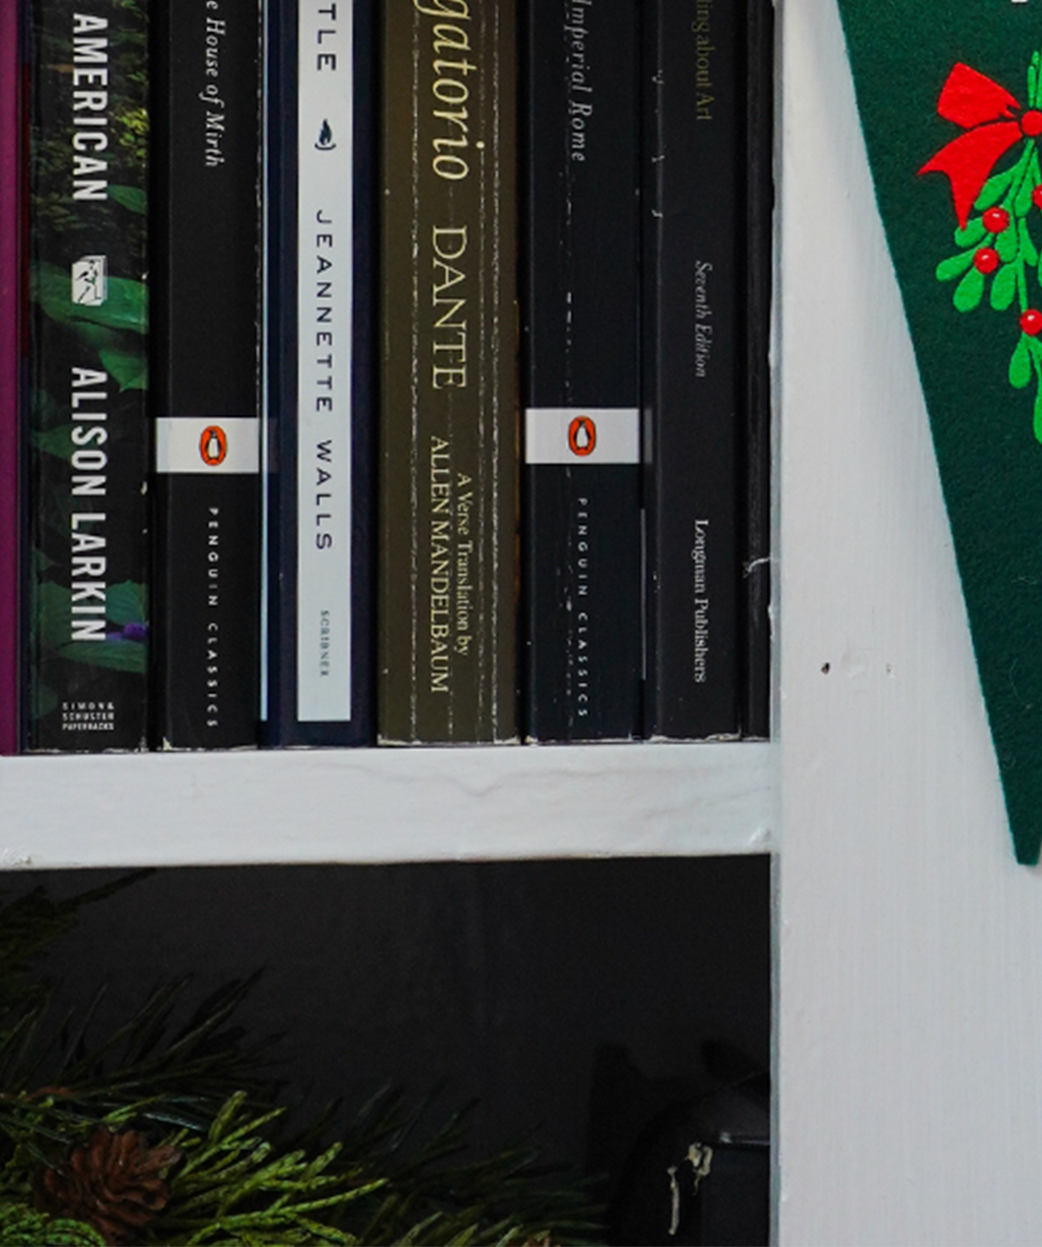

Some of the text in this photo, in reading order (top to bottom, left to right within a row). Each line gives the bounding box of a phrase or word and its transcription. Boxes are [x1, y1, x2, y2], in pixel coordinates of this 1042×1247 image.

[198, 80, 227, 104] of
[206, 17, 227, 77] House
[695, 35, 716, 88] about
[72, 13, 108, 201] AMERICAN
[206, 103, 227, 167] Mirth
[571, 101, 592, 161] Rome
[696, 92, 716, 121] Art
[432, 225, 469, 390] DANTE
[694, 260, 712, 378] Seventh Edition
[316, 210, 334, 550] JEANNETTE WALLS
[71, 367, 108, 641] ALISON LARKIN
[207, 507, 219, 728] PENGUIN CLASSICS
[431, 436, 449, 692] ALLEN MANDELBAUM
[456, 473, 470, 656] A Verse Translation by
[578, 498, 587, 718] PENGUIN CLASSICS
[690, 519, 710, 683] Longman Publishers
[320, 610, 330, 677] SCRIBNER
[62, 712, 114, 721] SCHUSTER
[62, 723, 114, 731] PAPERBACKS
